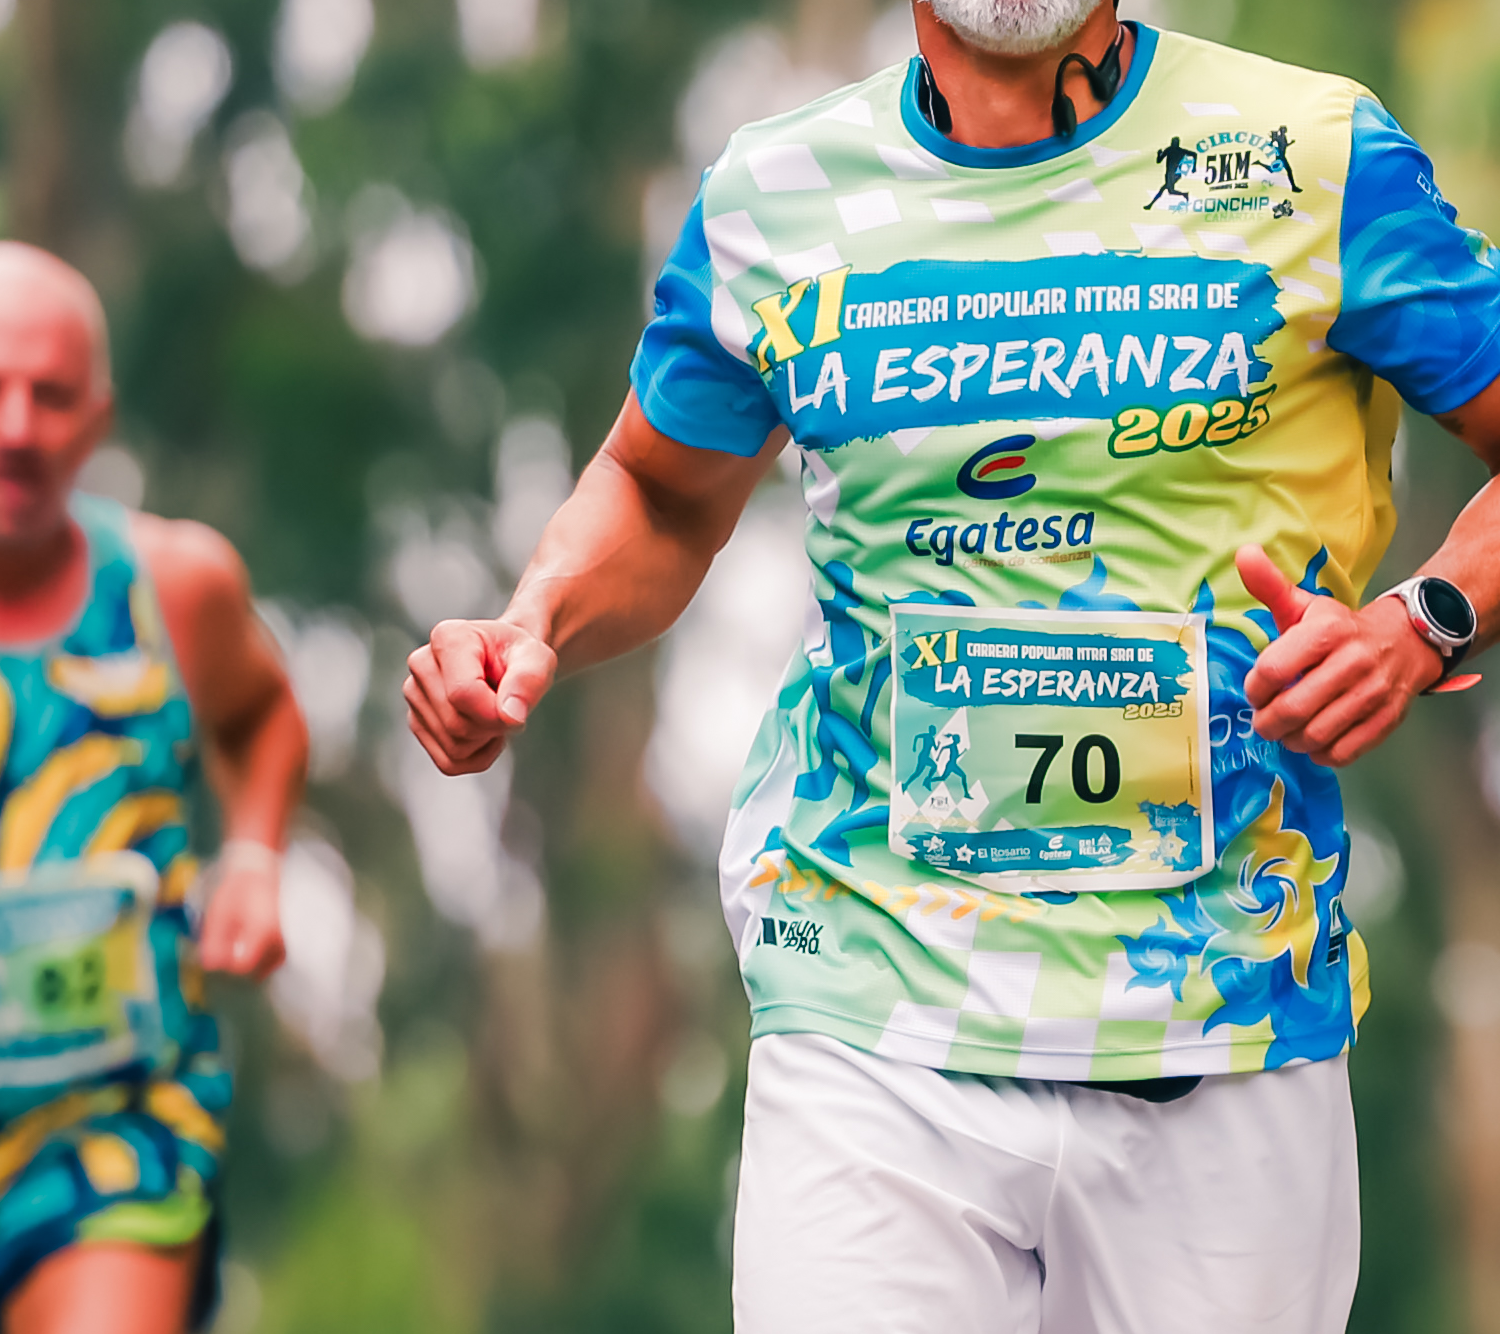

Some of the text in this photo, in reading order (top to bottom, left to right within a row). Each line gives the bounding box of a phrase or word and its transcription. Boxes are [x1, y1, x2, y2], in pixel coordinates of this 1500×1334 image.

[1204, 151, 1252, 185] 5KM
[1192, 196, 1270, 213] CONCHIP
[752, 264, 1240, 373] XI CARRERA POPULAR NTRA SRA DE
[787, 332, 1253, 415] LA ESPERANZA
[1110, 384, 1277, 457] 2025
[905, 512, 1095, 566] Egatesa
[910, 629, 1155, 670] XI CARRERA POPULAR NTRA SRA DE
[934, 665, 1160, 703] LA ESPERANZA
[1123, 701, 1183, 720] 2025
[1014, 733, 1122, 805] 70
[990, 847, 1031, 858] Rosario
[1079, 846, 1111, 856] RELAX
[787, 920, 824, 938] RUN
